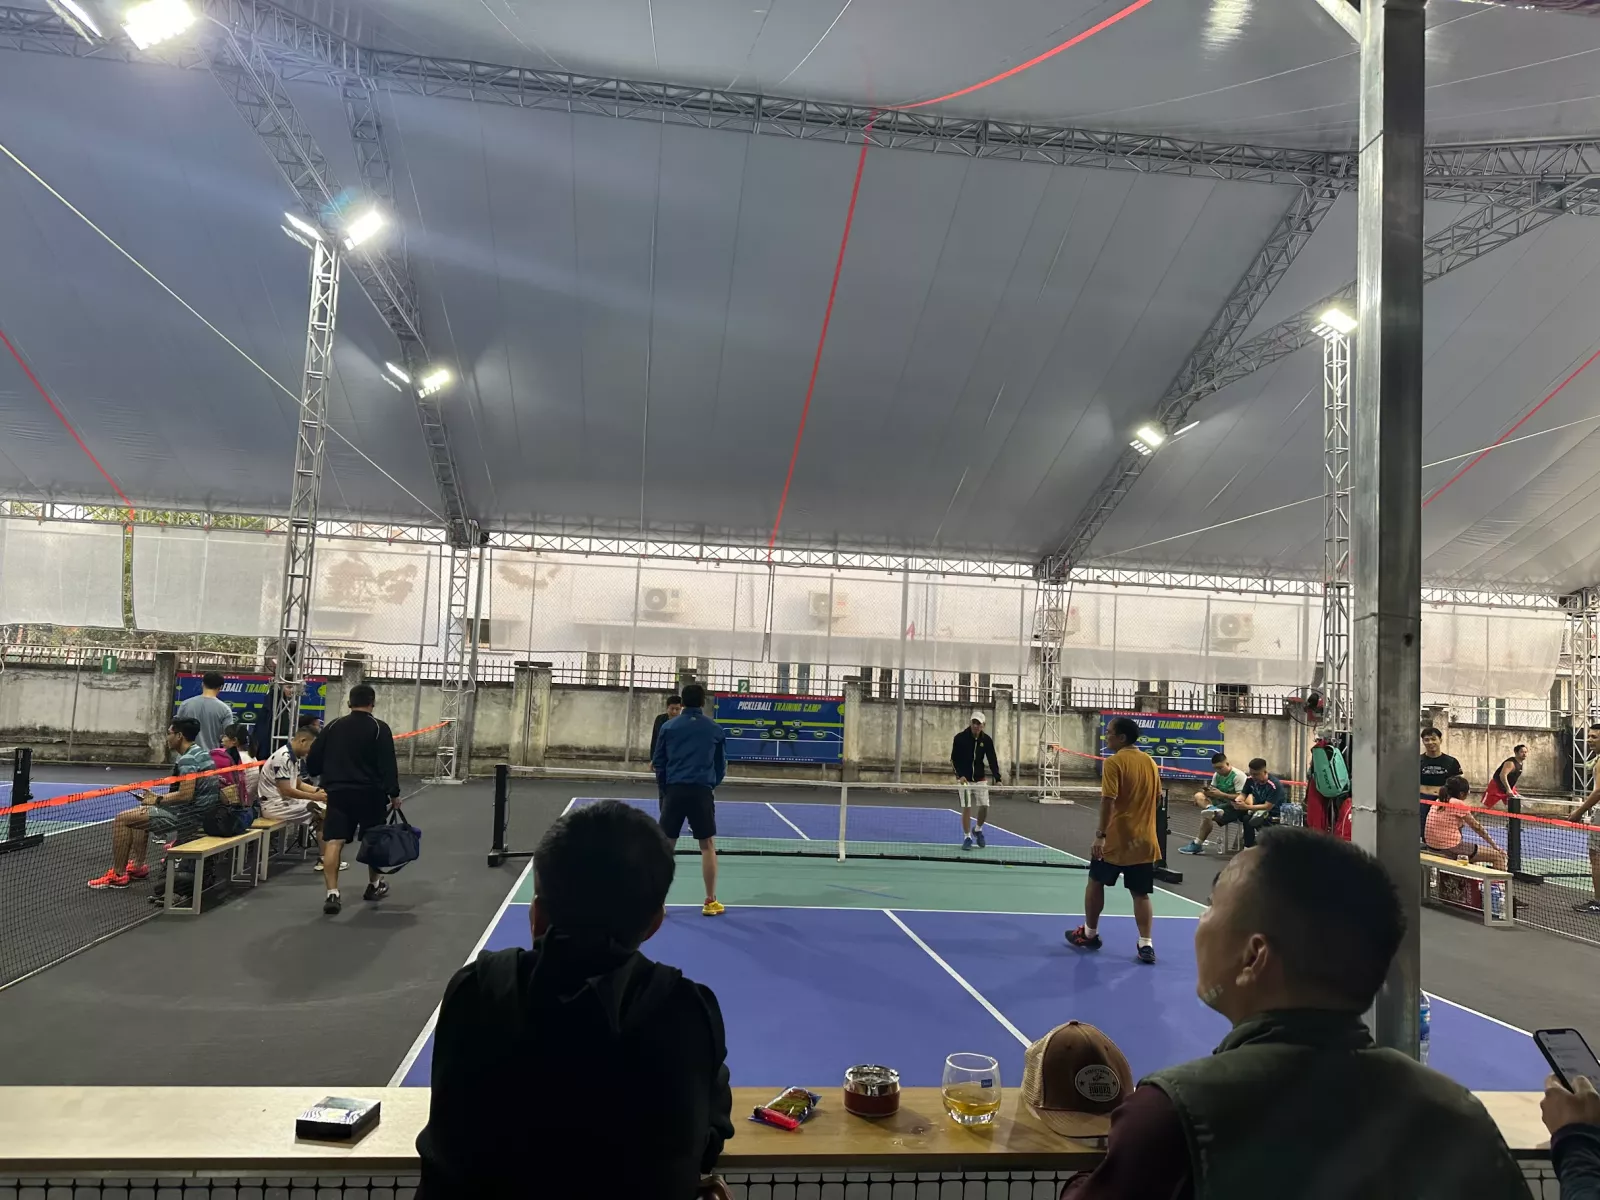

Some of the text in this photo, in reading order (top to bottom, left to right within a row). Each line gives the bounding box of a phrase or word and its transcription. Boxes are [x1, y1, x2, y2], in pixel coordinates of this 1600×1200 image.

[106, 657, 111, 670] 1
[740, 681, 747, 693] 2
[737, 701, 821, 712] PICKLEBALL TRAINING CAMP
[1186, 721, 1203, 730] CAMP
